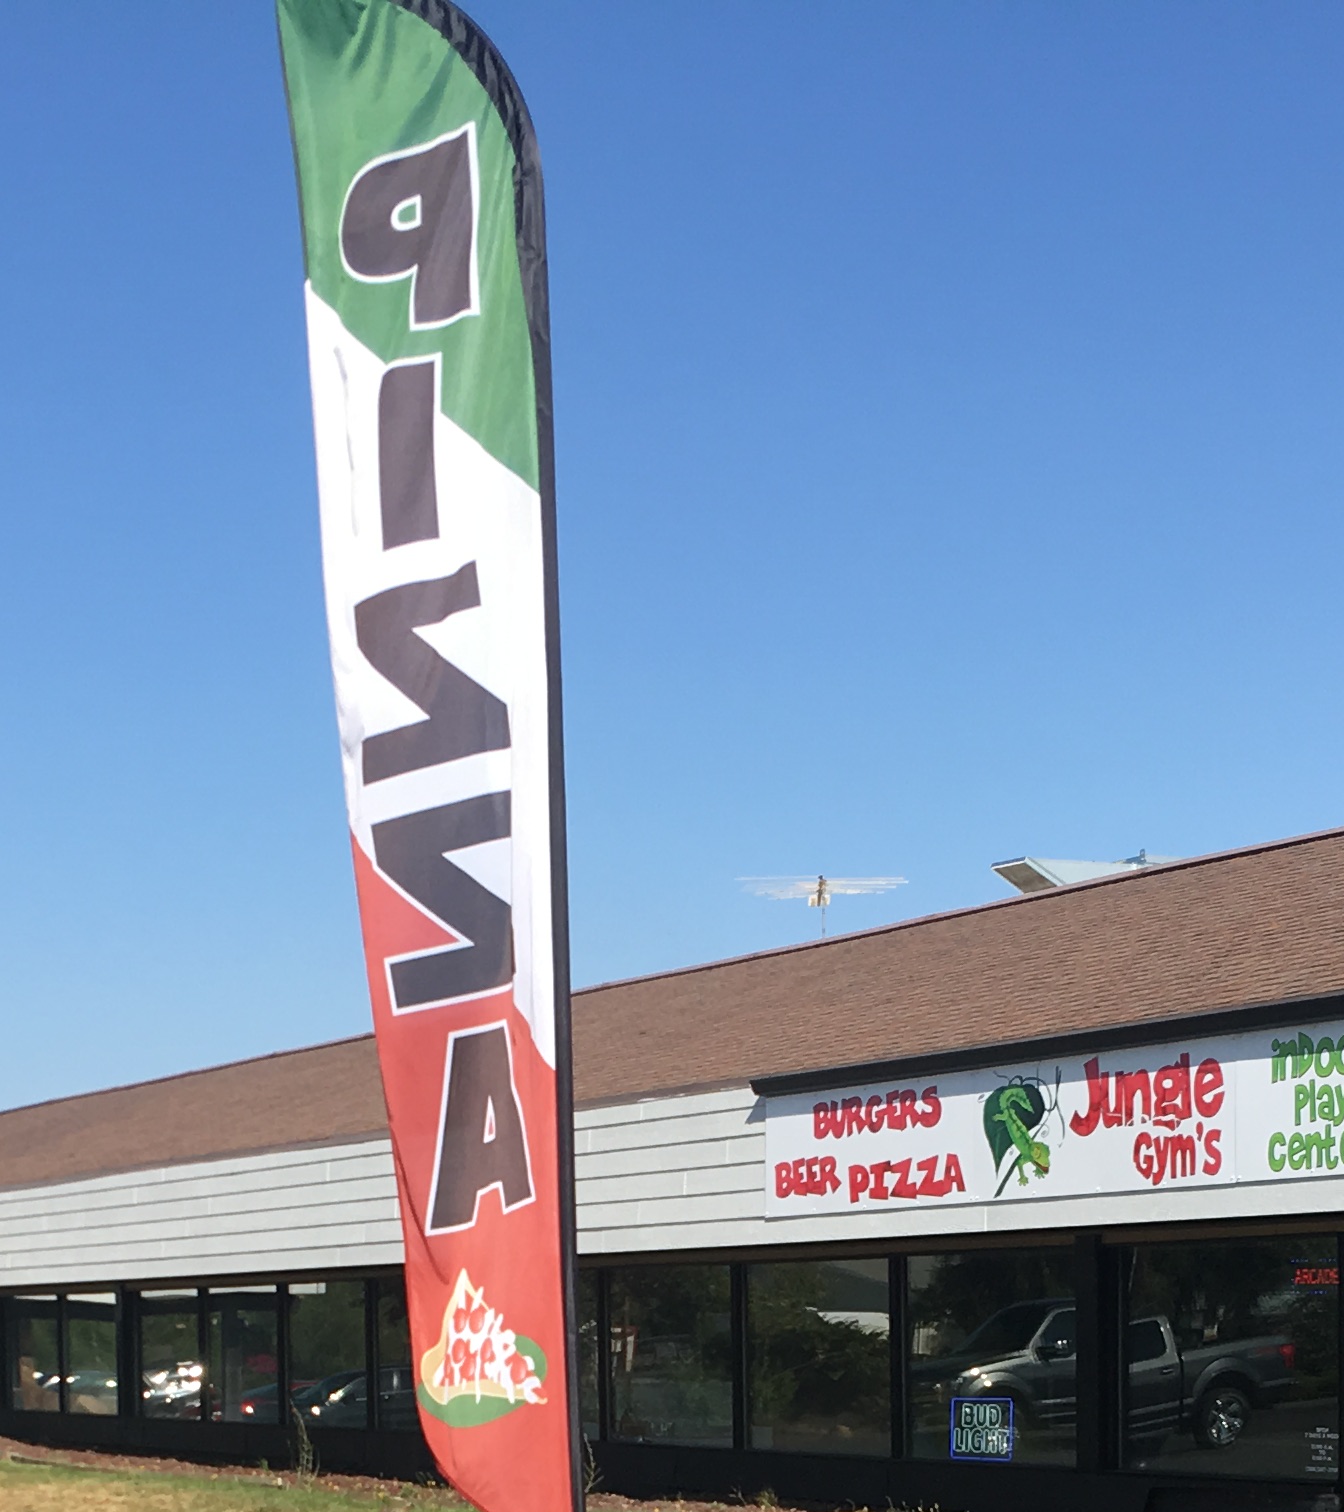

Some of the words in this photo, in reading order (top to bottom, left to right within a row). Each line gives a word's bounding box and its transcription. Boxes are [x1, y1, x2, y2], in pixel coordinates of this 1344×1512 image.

[812, 1085, 942, 1139] BURGERS
[1069, 1052, 1225, 1137] Jungle
[774, 1155, 842, 1199] BEER
[848, 1153, 966, 1203] PIZZA
[1133, 1121, 1222, 1186] Gym's
[1295, 1268, 1340, 1285] ARCADE
[961, 1402, 1002, 1428] BUD
[954, 1427, 1010, 1454] LIGHT
